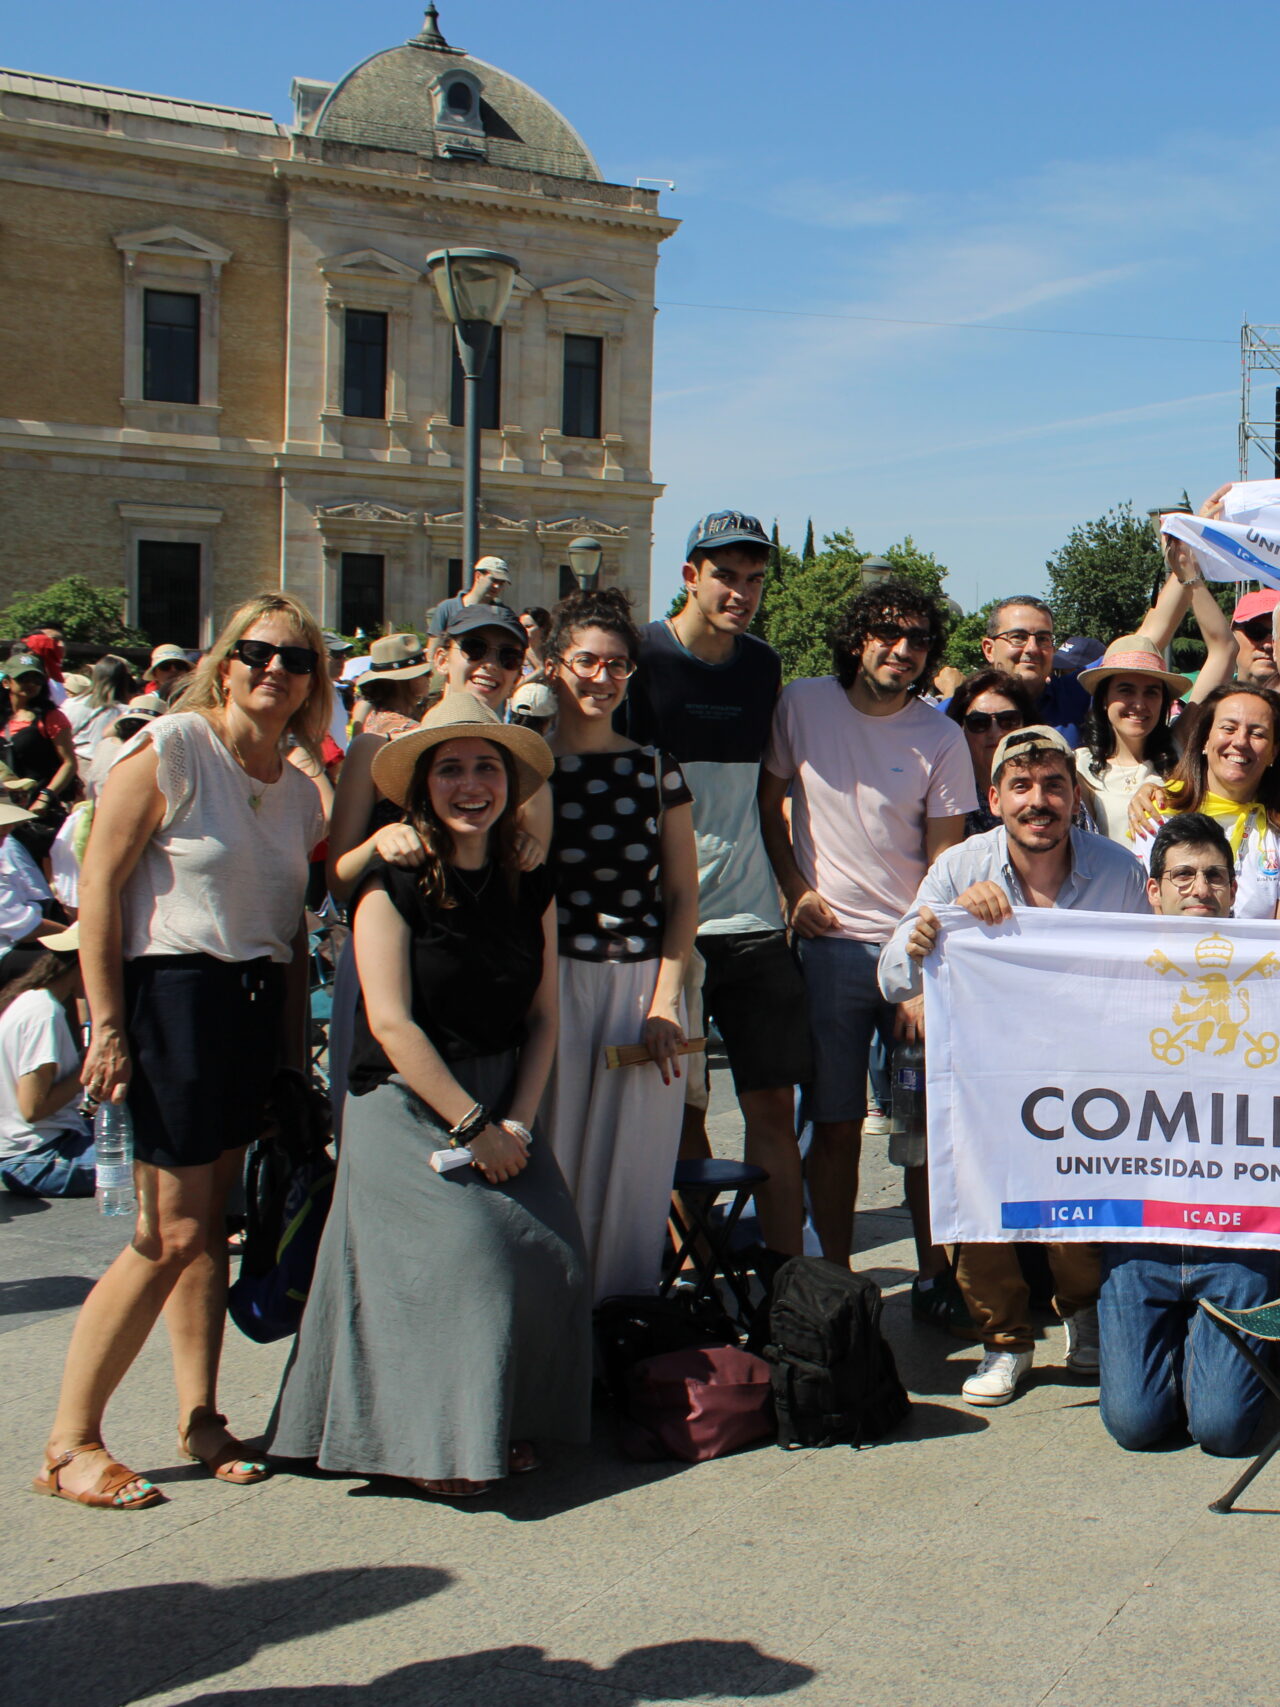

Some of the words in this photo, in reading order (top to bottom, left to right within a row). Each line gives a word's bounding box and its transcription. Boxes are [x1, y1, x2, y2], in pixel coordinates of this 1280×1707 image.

[1056, 1156, 1223, 1179] UNIVERSIDAD
[1050, 1206, 1094, 1221] ICAI
[1183, 1210, 1242, 1227] ICADE
